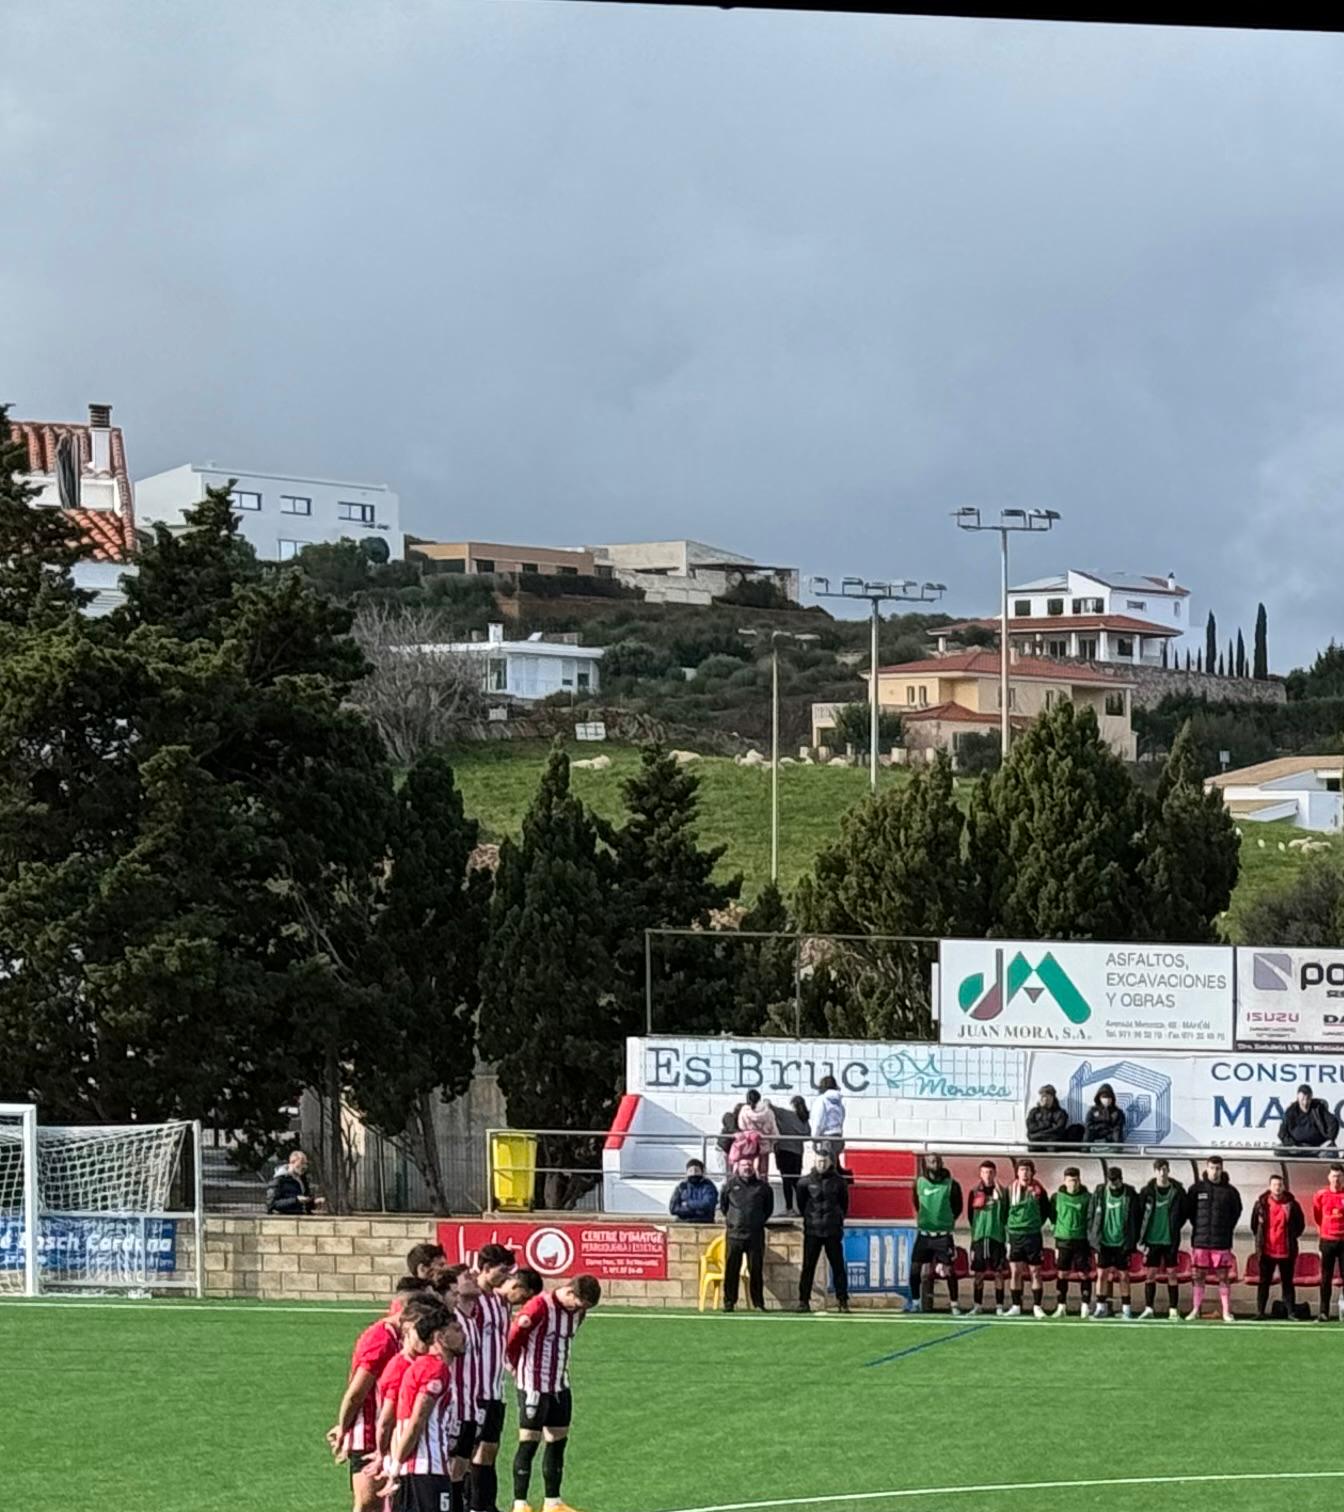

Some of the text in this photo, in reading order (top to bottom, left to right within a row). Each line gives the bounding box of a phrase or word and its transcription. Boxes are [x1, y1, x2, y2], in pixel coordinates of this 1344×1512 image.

[1105, 952, 1189, 970] ASFALTOS,
[1106, 972, 1227, 990] EXCAVACIONES
[1106, 992, 1176, 1008] Y OBRAS
[1247, 1012, 1299, 1023] ISUZU
[957, 1024, 999, 1039] JUAN
[1004, 1025, 1059, 1041] MORA,
[646, 1047, 870, 1092] Es Bruc
[440, 1492, 450, 1511] 5
